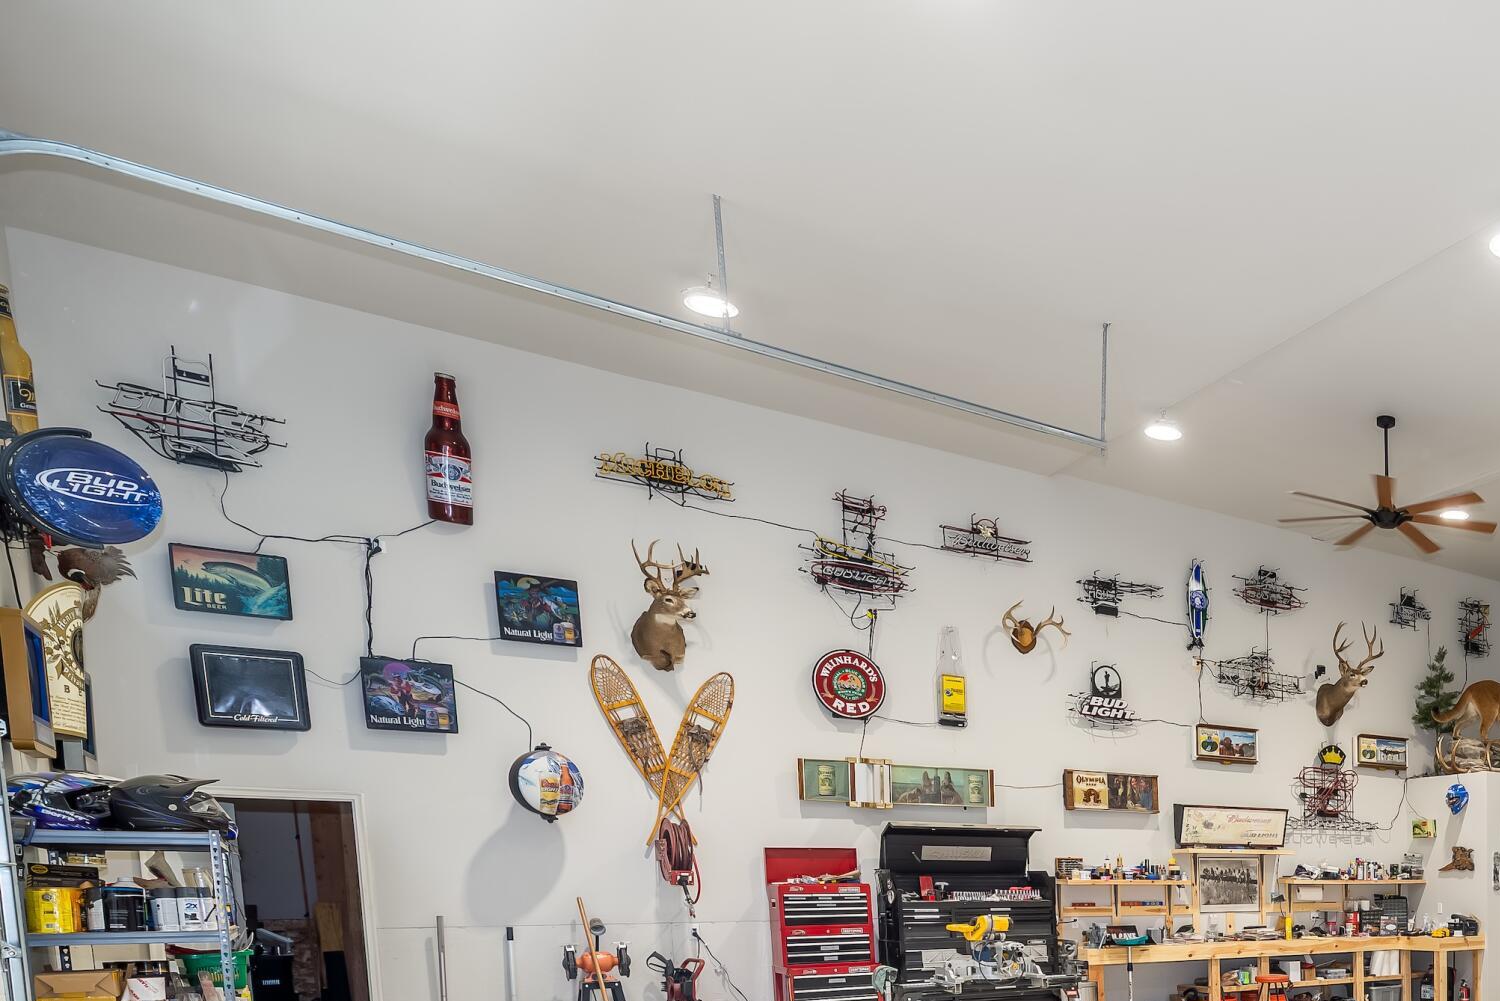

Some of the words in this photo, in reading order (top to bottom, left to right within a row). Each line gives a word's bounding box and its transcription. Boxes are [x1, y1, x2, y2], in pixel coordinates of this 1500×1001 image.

[66, 471, 138, 491] BUD
[50, 479, 148, 502] LIGHT
[182, 587, 227, 606] Lite
[504, 627, 531, 638] Natural
[533, 628, 552, 641] Light
[820, 655, 878, 682] WEINHARD'S
[832, 698, 870, 713] RED
[1090, 697, 1128, 709] BUD
[1081, 706, 1135, 719] LIGHT
[370, 714, 400, 725] Natural
[403, 716, 425, 728] Light
[1075, 774, 1107, 785] OLYMPIA
